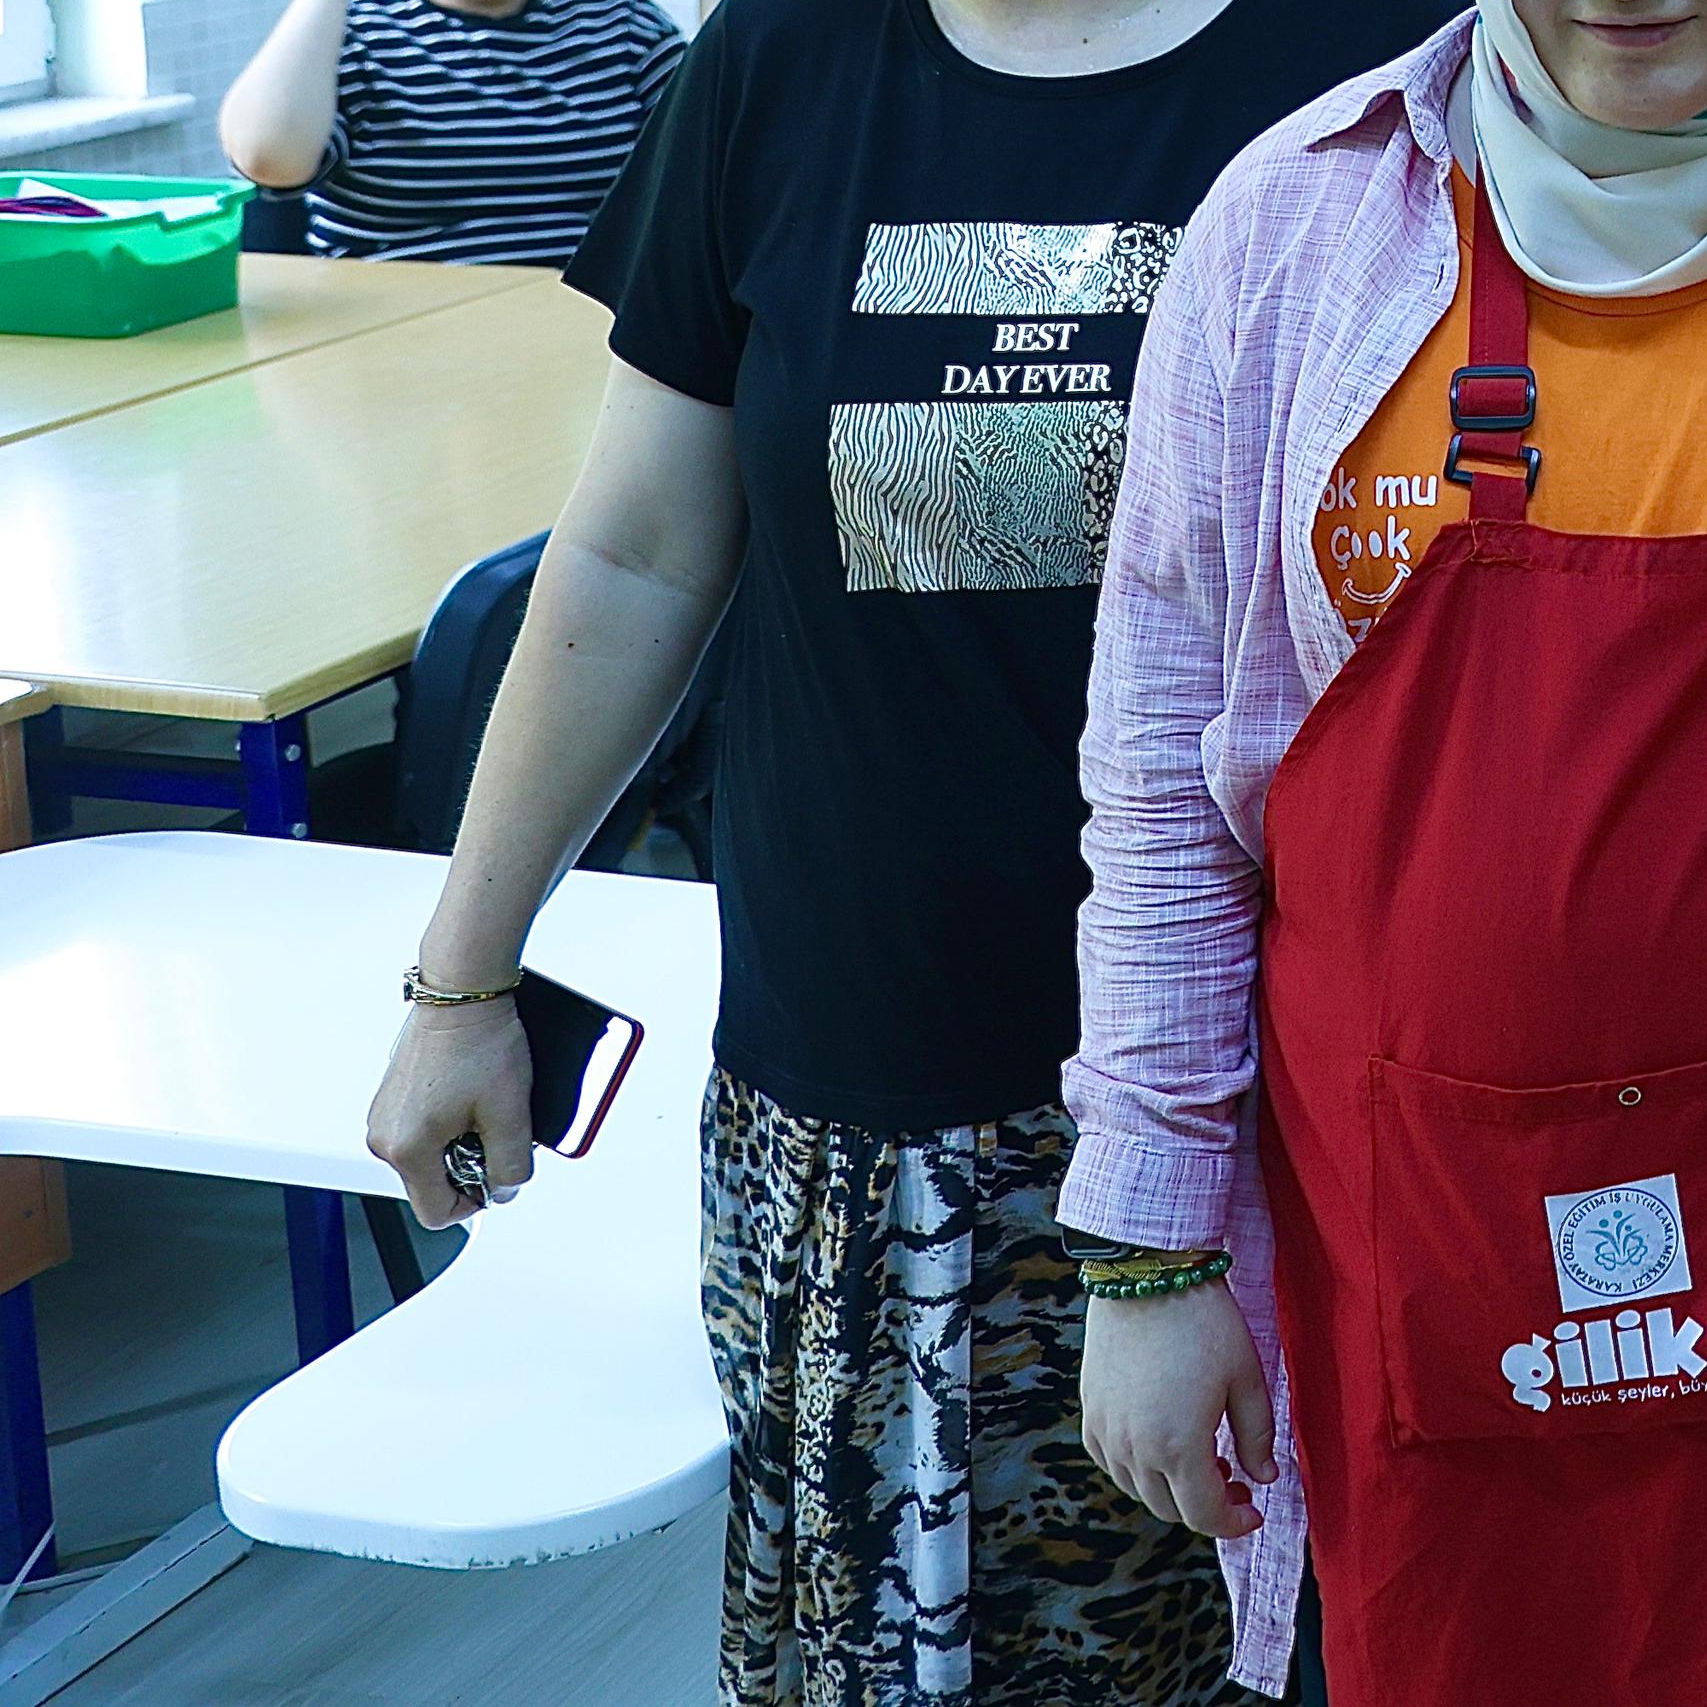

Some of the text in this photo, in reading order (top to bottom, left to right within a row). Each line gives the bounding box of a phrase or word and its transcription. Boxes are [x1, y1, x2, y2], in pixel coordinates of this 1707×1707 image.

[992, 323, 1080, 352] BEST
[941, 364, 1112, 394] DAY EVER
[1375, 474, 1438, 508] mu
[1568, 1262, 1622, 1293] KARATAY
[1561, 1390, 1612, 1406] küçük
